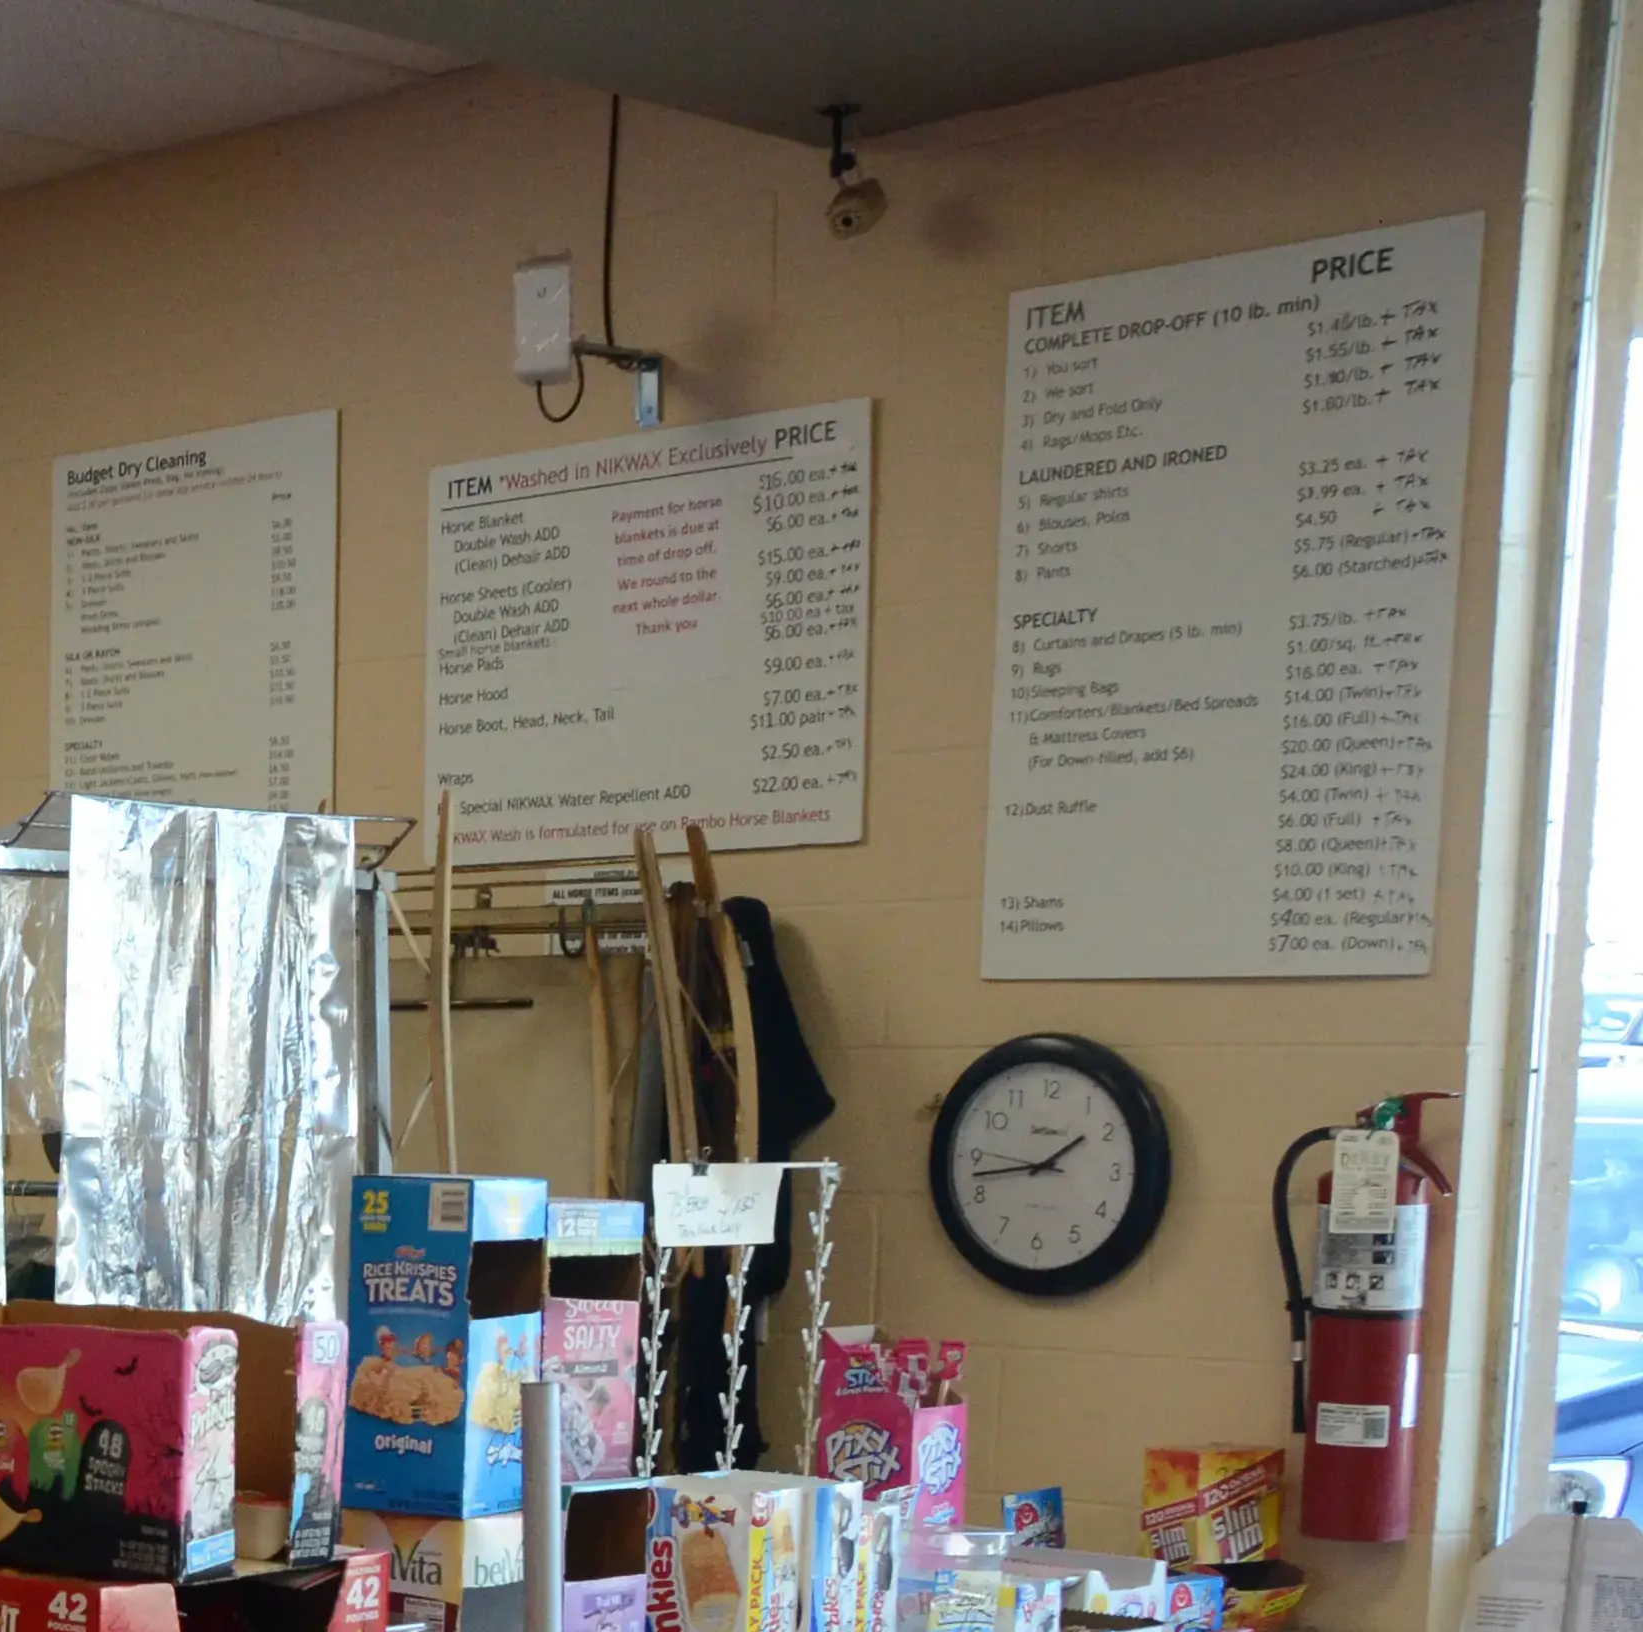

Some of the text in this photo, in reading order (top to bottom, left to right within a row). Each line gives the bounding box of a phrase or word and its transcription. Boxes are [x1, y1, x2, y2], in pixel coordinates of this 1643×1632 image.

[1311, 247, 1394, 284] PRICE
[1024, 294, 1320, 354] COMPLETE DROP-OFF (10 lb. min)
[1026, 301, 1086, 330] ITEM
[67, 449, 207, 486] Budget Dry Cleaning
[447, 420, 837, 501] ITEM in NIKWAX Exclusively PRICE
[1018, 444, 1228, 486] LAUNDERED AND IRONED
[441, 511, 524, 536] Horse Blanket
[634, 619, 671, 636] Thank
[1013, 608, 1098, 631] SPECIALTY
[439, 657, 505, 677] Horse Pads
[438, 772, 474, 788] Wraps
[753, 774, 799, 795] $22.00
[1020, 918, 1065, 934] Pillows
[1009, 1090, 1024, 1108] 11
[1043, 1079, 1060, 1099] 12
[985, 1111, 1008, 1130] 10
[1102, 1122, 1114, 1142] 2
[971, 1148, 982, 1165] 9
[1109, 1163, 1120, 1182] 3
[363, 1190, 389, 1214] 25
[974, 1186, 985, 1203] 8
[1095, 1201, 1107, 1218] 4
[999, 1216, 1009, 1235] 7
[1068, 1225, 1080, 1244] 5
[1031, 1232, 1042, 1250] 6
[363, 1260, 457, 1282] RICE KRISPIES
[365, 1278, 454, 1308] TREATS
[314, 1335, 339, 1361] 50
[98, 1428, 124, 1459] 48
[375, 1434, 433, 1454] Original
[346, 1576, 380, 1609] 42
[47, 1591, 87, 1622] 42
